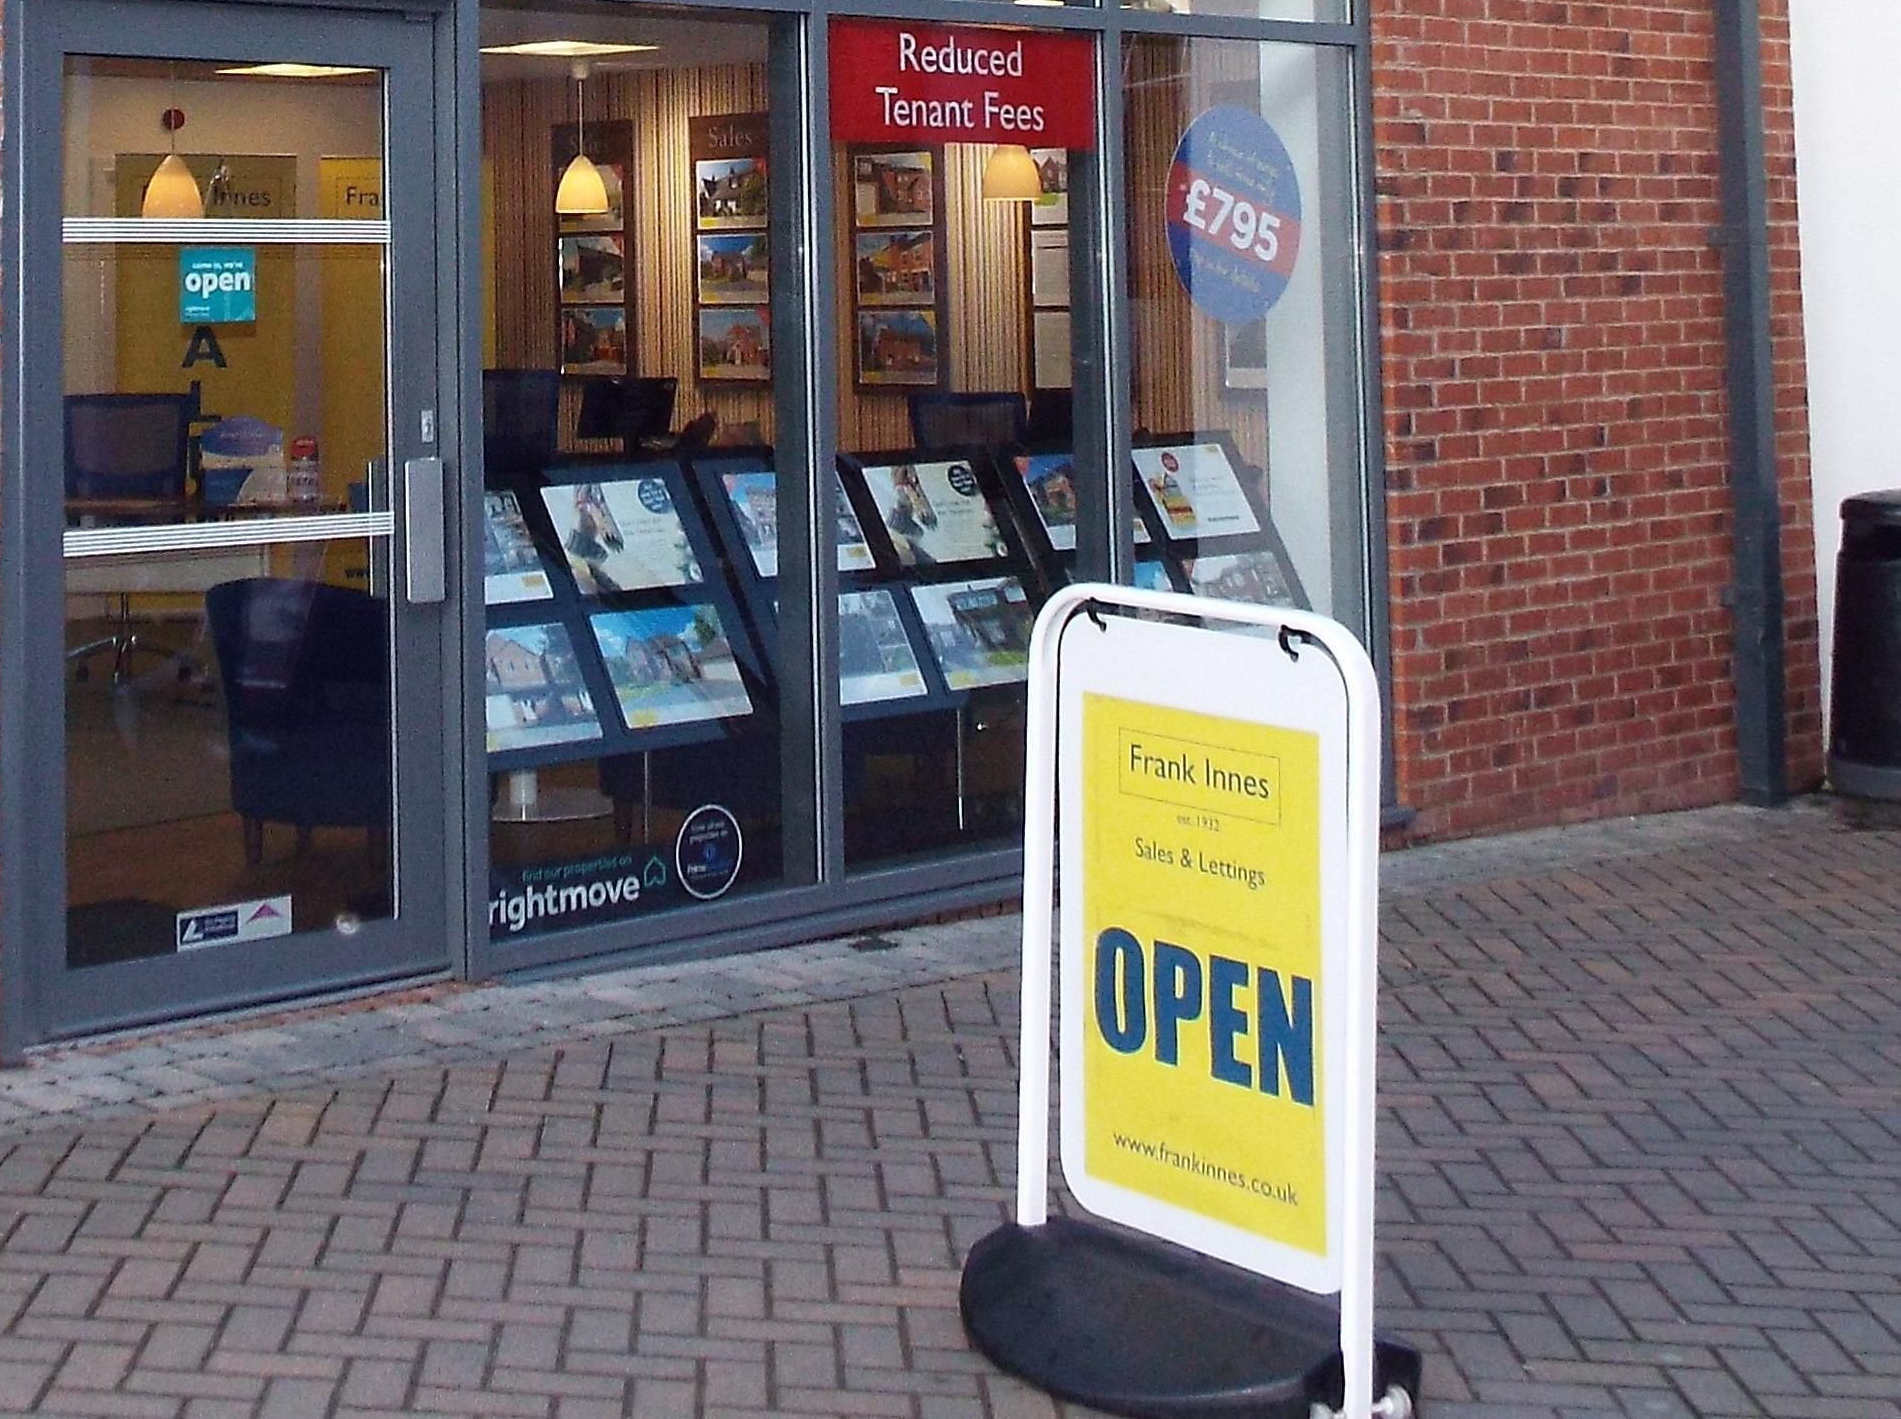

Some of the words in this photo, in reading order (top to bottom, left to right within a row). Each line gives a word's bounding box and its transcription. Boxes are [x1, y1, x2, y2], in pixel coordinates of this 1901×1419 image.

[898, 32, 1023, 78] Reduced
[875, 86, 974, 129] Tenant
[984, 91, 1045, 132] Fees
[708, 123, 753, 149] Sales
[346, 186, 380, 207] Fra
[1183, 178, 1281, 262] £795
[185, 272, 251, 299] open
[1130, 743, 1196, 785] Frank
[1206, 758, 1270, 799] Innes
[1197, 816, 1219, 832] 1932
[1136, 837, 1174, 865] Sales
[1180, 848, 1192, 869] &
[1199, 851, 1265, 891] Lettings
[489, 874, 641, 932] rightmove
[1094, 926, 1316, 1108] OPEN
[1113, 1131, 1299, 1206] www.frankinnes.co.uk
